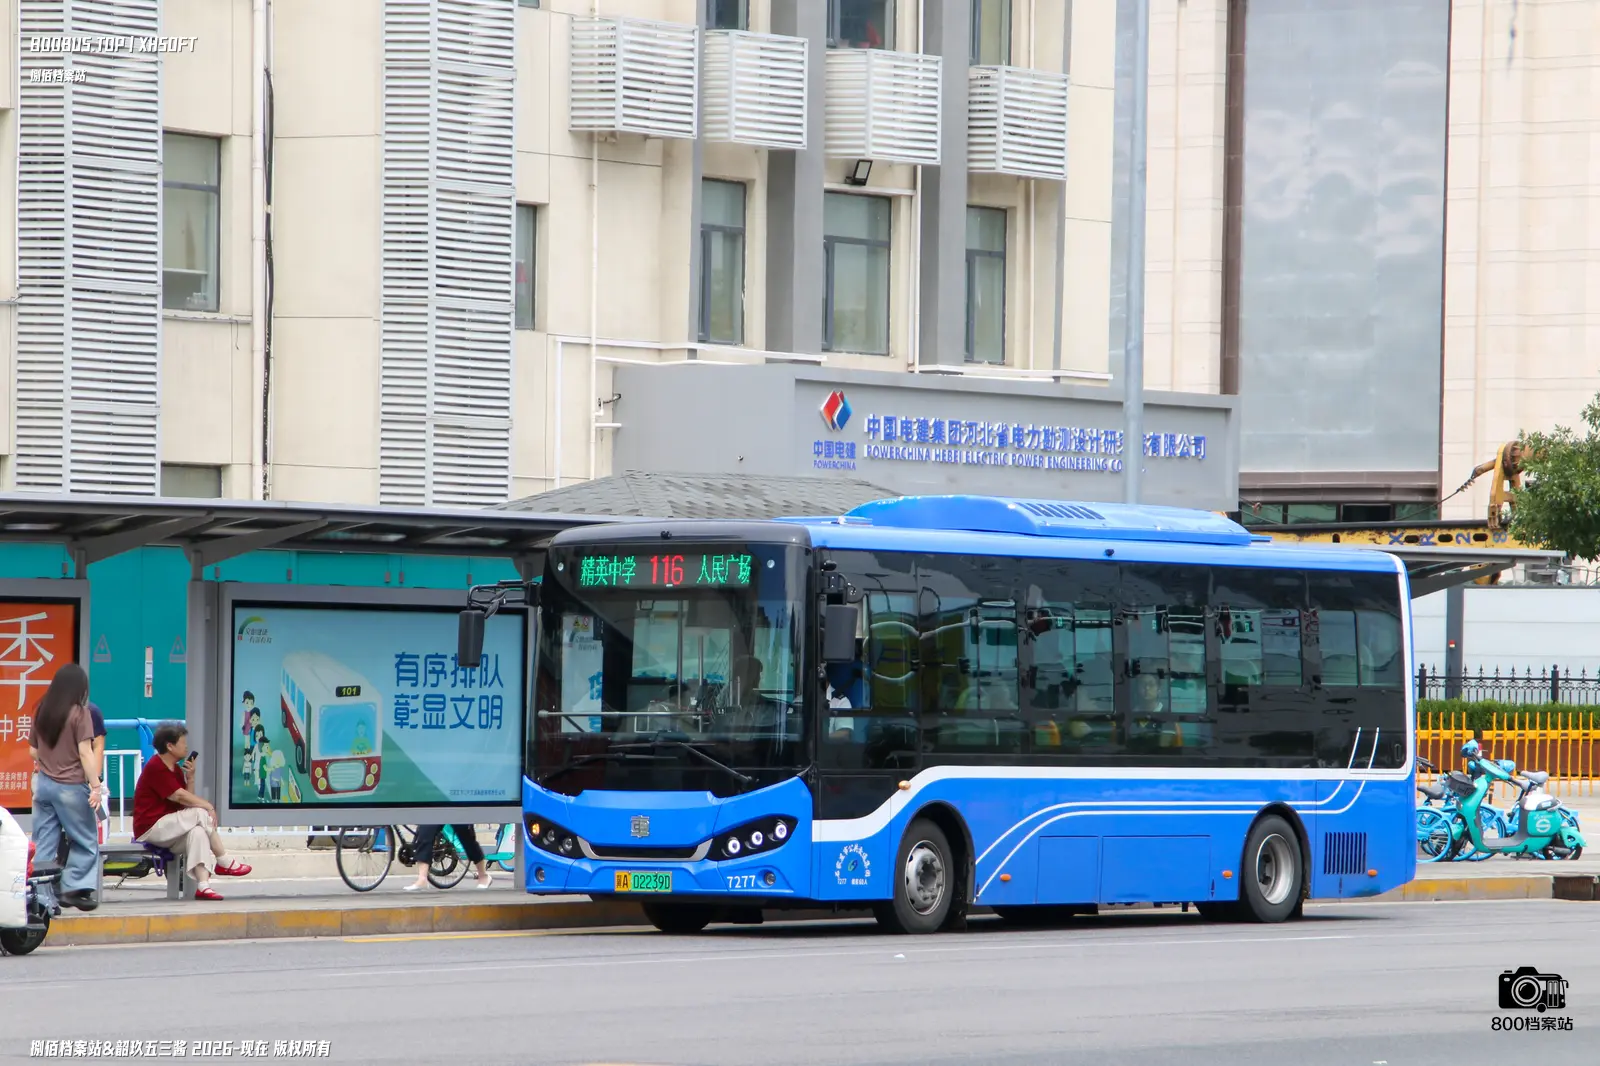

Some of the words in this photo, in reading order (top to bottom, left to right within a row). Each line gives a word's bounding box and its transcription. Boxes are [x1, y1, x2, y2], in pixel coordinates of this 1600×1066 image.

[813, 440, 856, 459] 中国电建
[864, 414, 1206, 460] 中国电建集团河北省电力勘测设计研有限公司
[813, 460, 856, 470] POWERCHINA
[864, 444, 930, 461] POWERCHINA
[932, 448, 962, 463] HEBEI
[963, 449, 1008, 466] ELECTRIC
[1009, 453, 1044, 468] POWER
[1045, 456, 1108, 471] ENGINEERING
[580, 555, 636, 586] 精英中学
[650, 555, 684, 585] 116
[696, 554, 752, 584] 人民广场
[0, 612, 54, 710] 季
[394, 651, 504, 688] 有序排队
[341, 687, 357, 696] 101
[394, 693, 503, 730] 彰显文明
[727, 875, 756, 889] 7277
